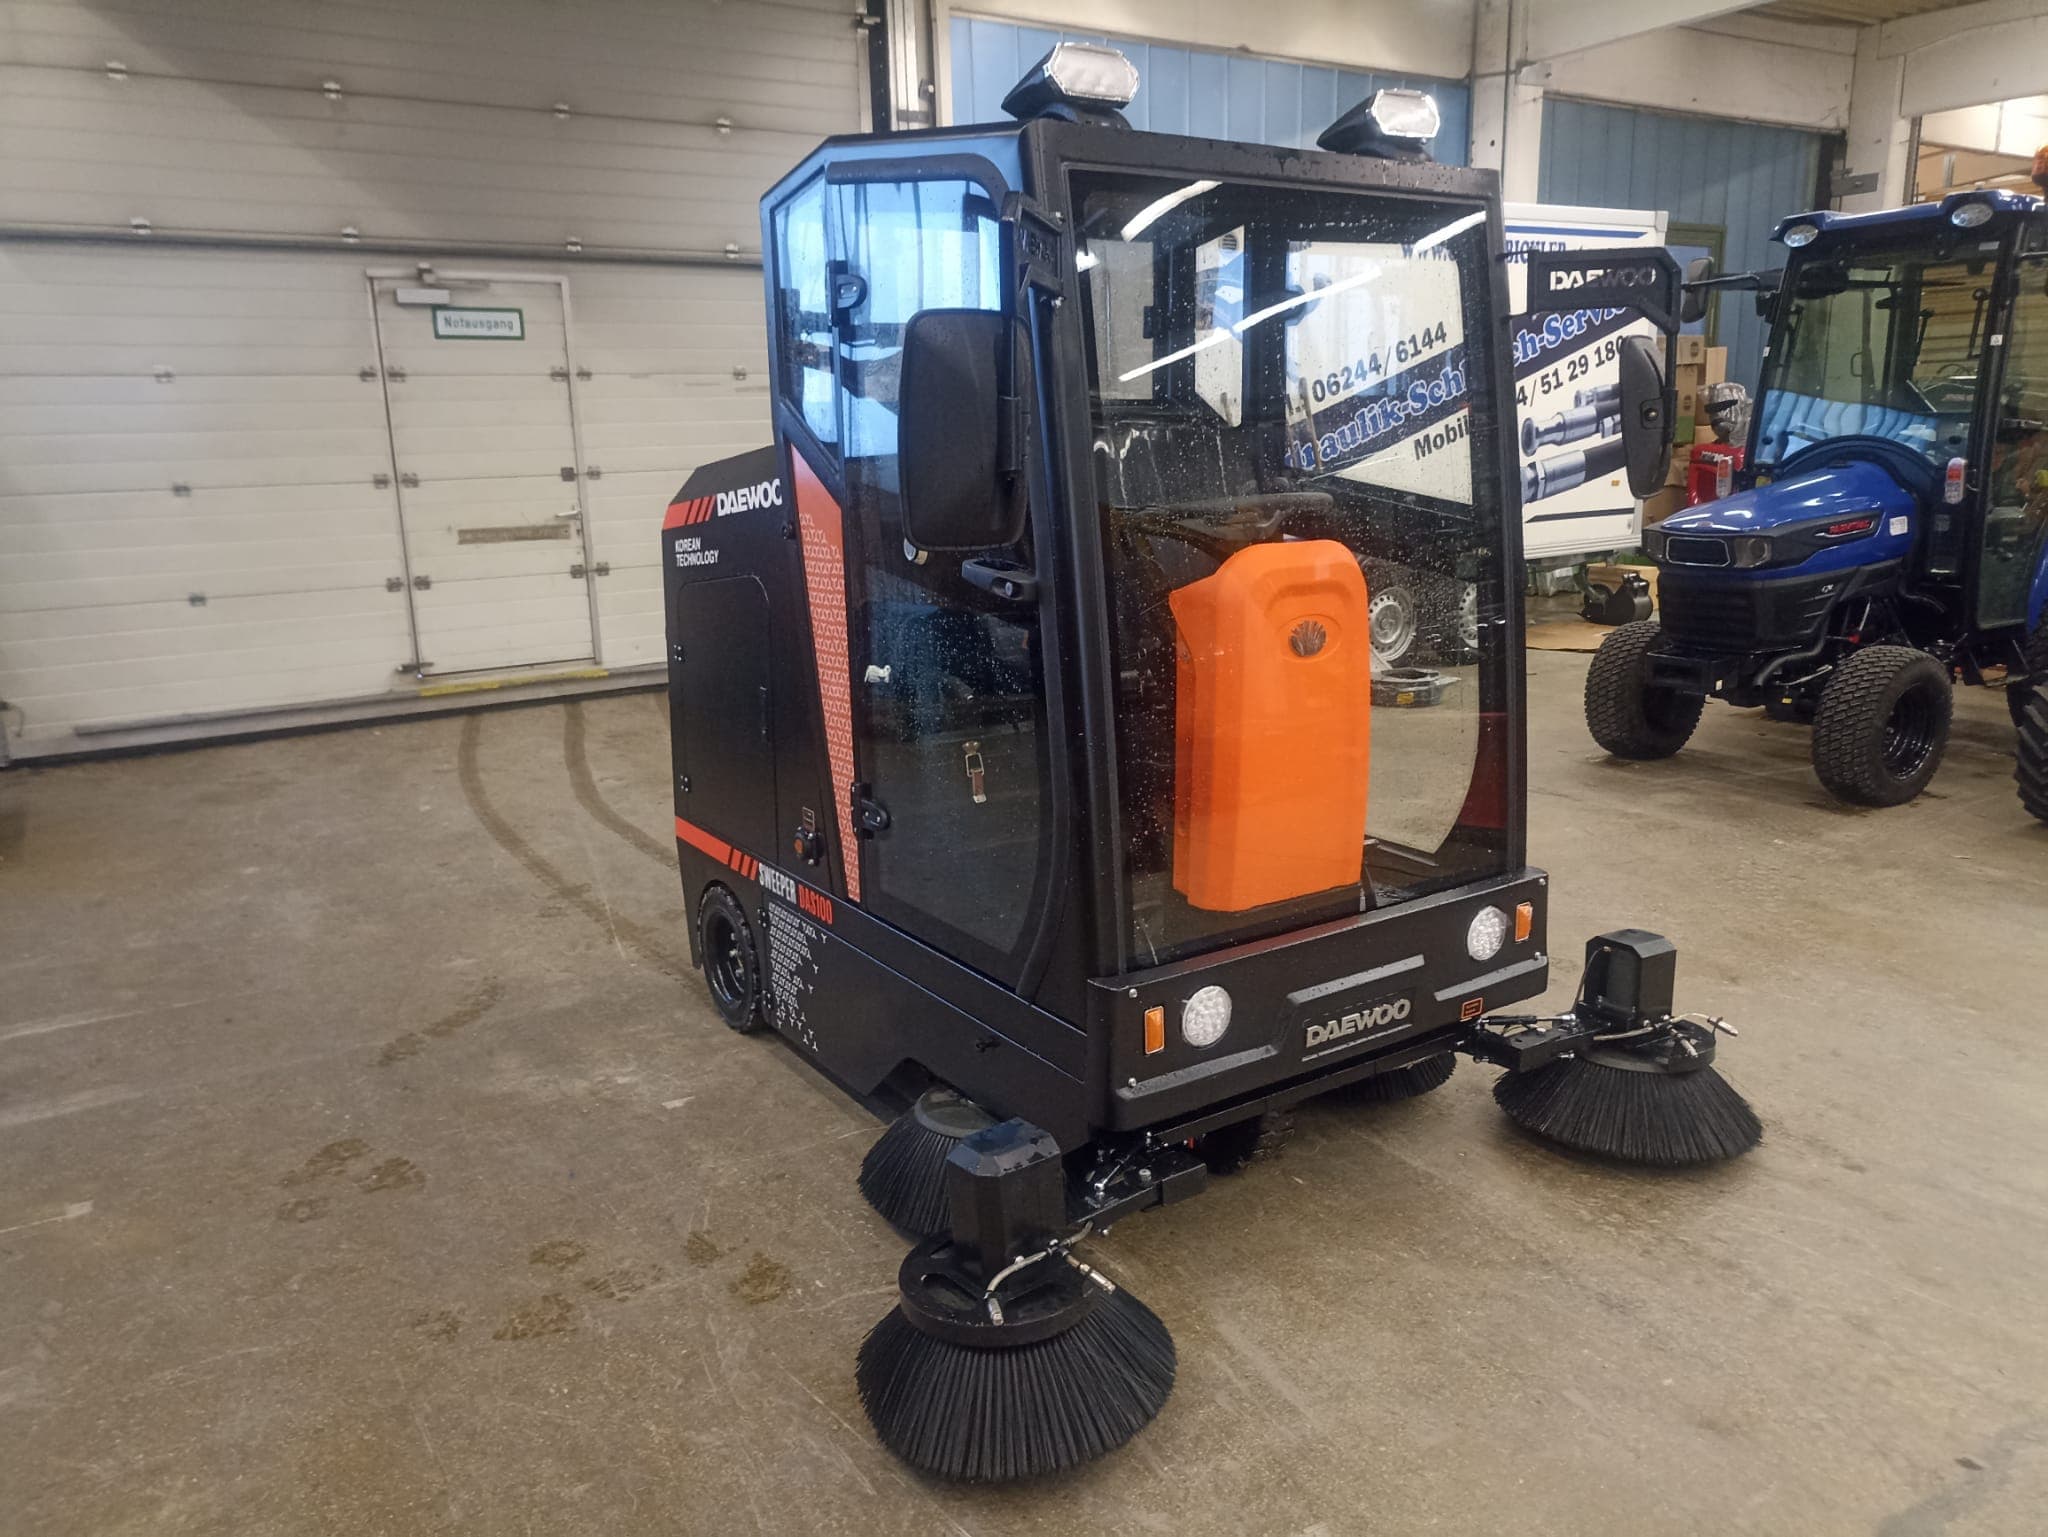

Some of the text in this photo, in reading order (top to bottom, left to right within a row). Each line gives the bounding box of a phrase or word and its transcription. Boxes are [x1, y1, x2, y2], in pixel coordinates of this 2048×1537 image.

[1549, 268, 1656, 291] DAEWOO
[443, 315, 514, 331] Notausgang
[1414, 415, 1468, 461] Mobil
[1567, 354, 1589, 382] 29
[675, 537, 702, 553] KOREAN
[676, 550, 720, 567] TECHNOLOGY
[758, 862, 833, 925] SWEEPER DAS100
[1306, 998, 1412, 1048] DAEWOO
